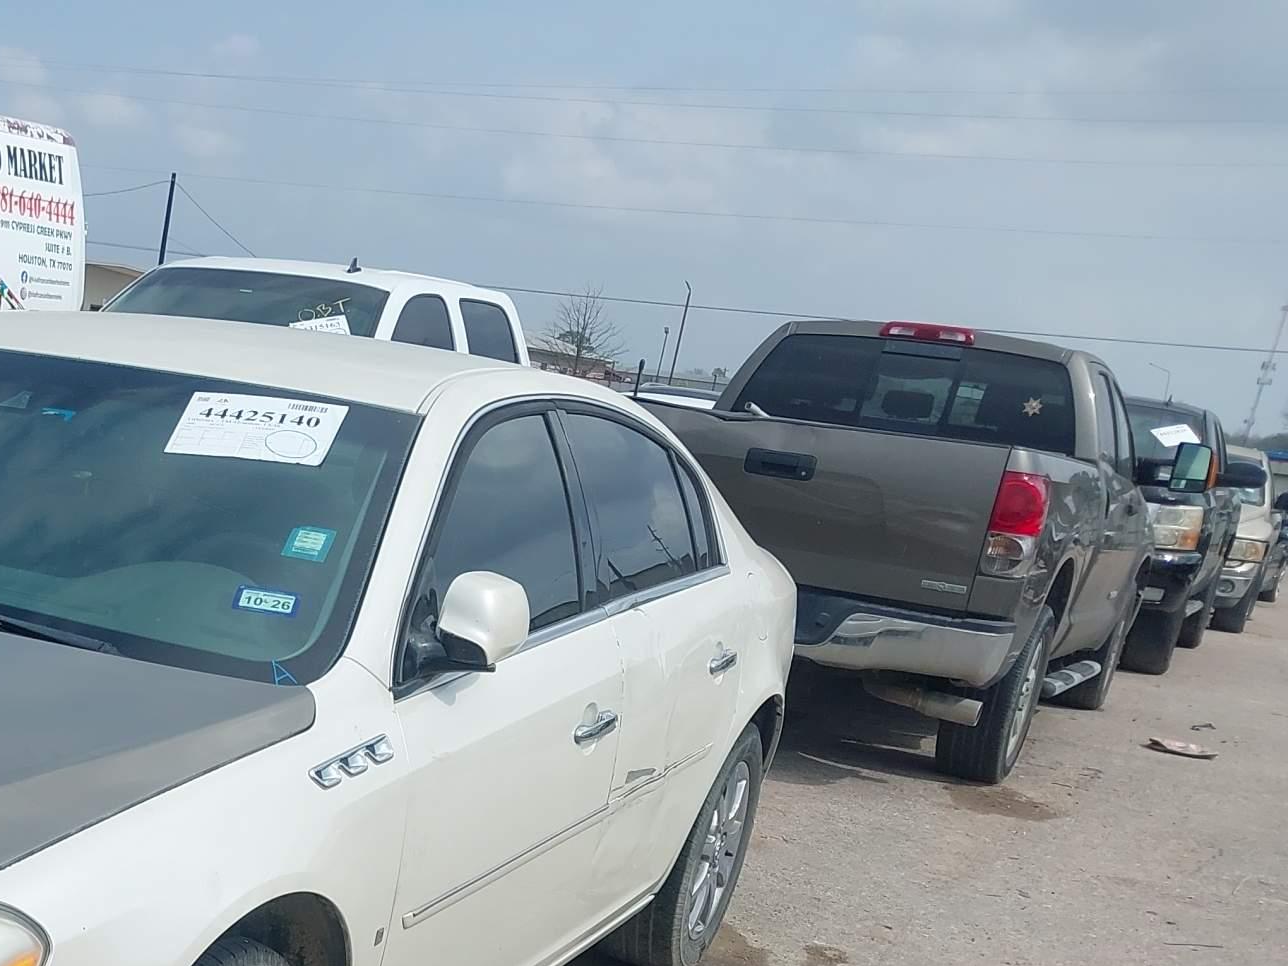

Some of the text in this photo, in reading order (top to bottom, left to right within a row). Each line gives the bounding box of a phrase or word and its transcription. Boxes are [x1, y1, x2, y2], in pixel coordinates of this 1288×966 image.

[6, 145, 64, 185] MARKET
[11, 220, 35, 234] CYPRESS
[36, 225, 55, 238] CREEK
[56, 229, 72, 241] PKWY
[45, 242, 59, 254] SUITE
[18, 252, 72, 271] HOUSTON, TX 77070
[199, 407, 321, 429] 44425140
